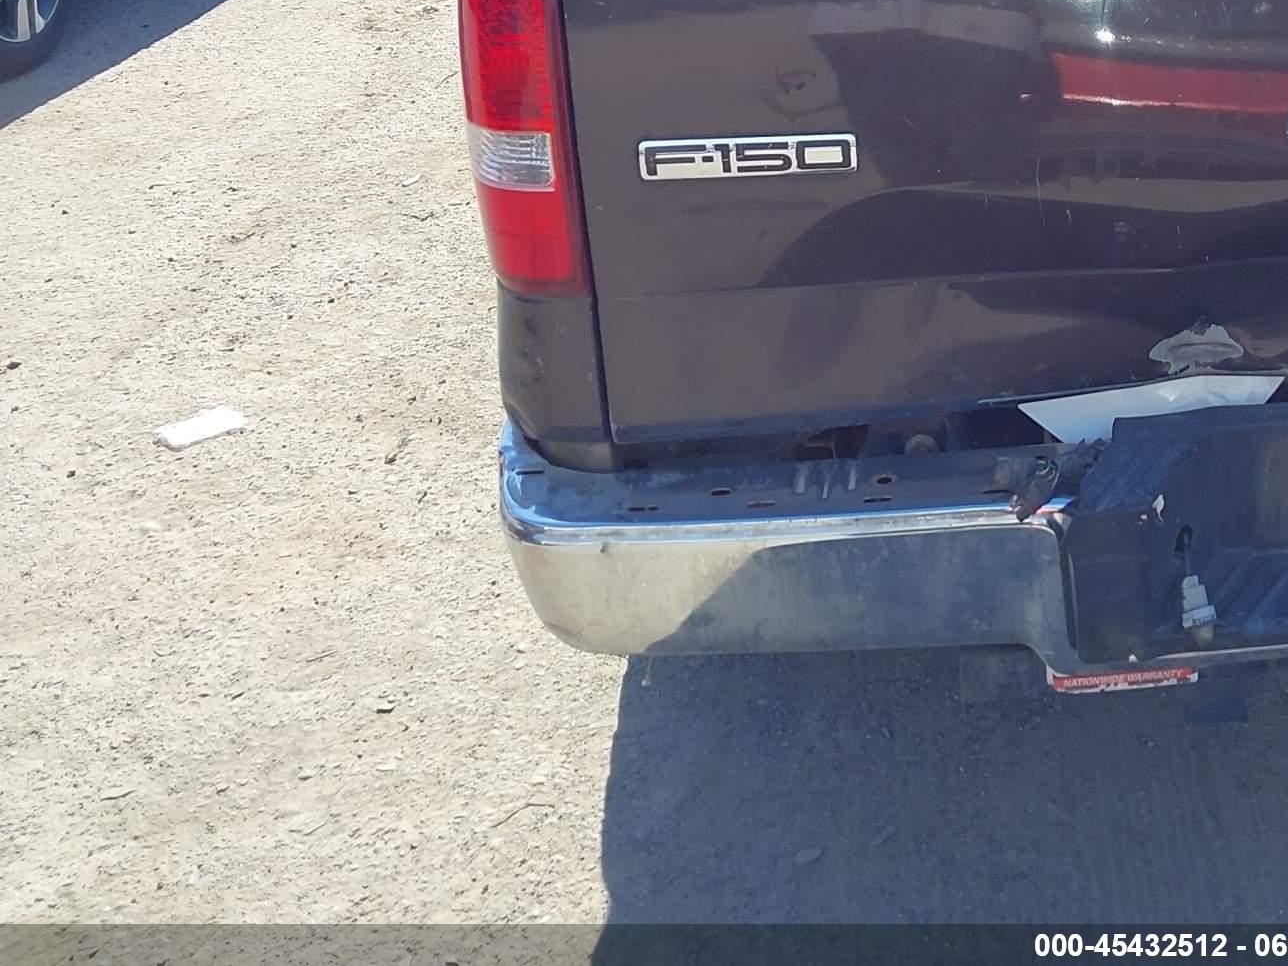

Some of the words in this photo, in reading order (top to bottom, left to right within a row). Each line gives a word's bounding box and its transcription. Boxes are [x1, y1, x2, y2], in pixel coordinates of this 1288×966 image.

[643, 139, 853, 177] F-150
[1063, 672, 1125, 687] NATIONWIDE
[1127, 668, 1184, 682] WARRANTY
